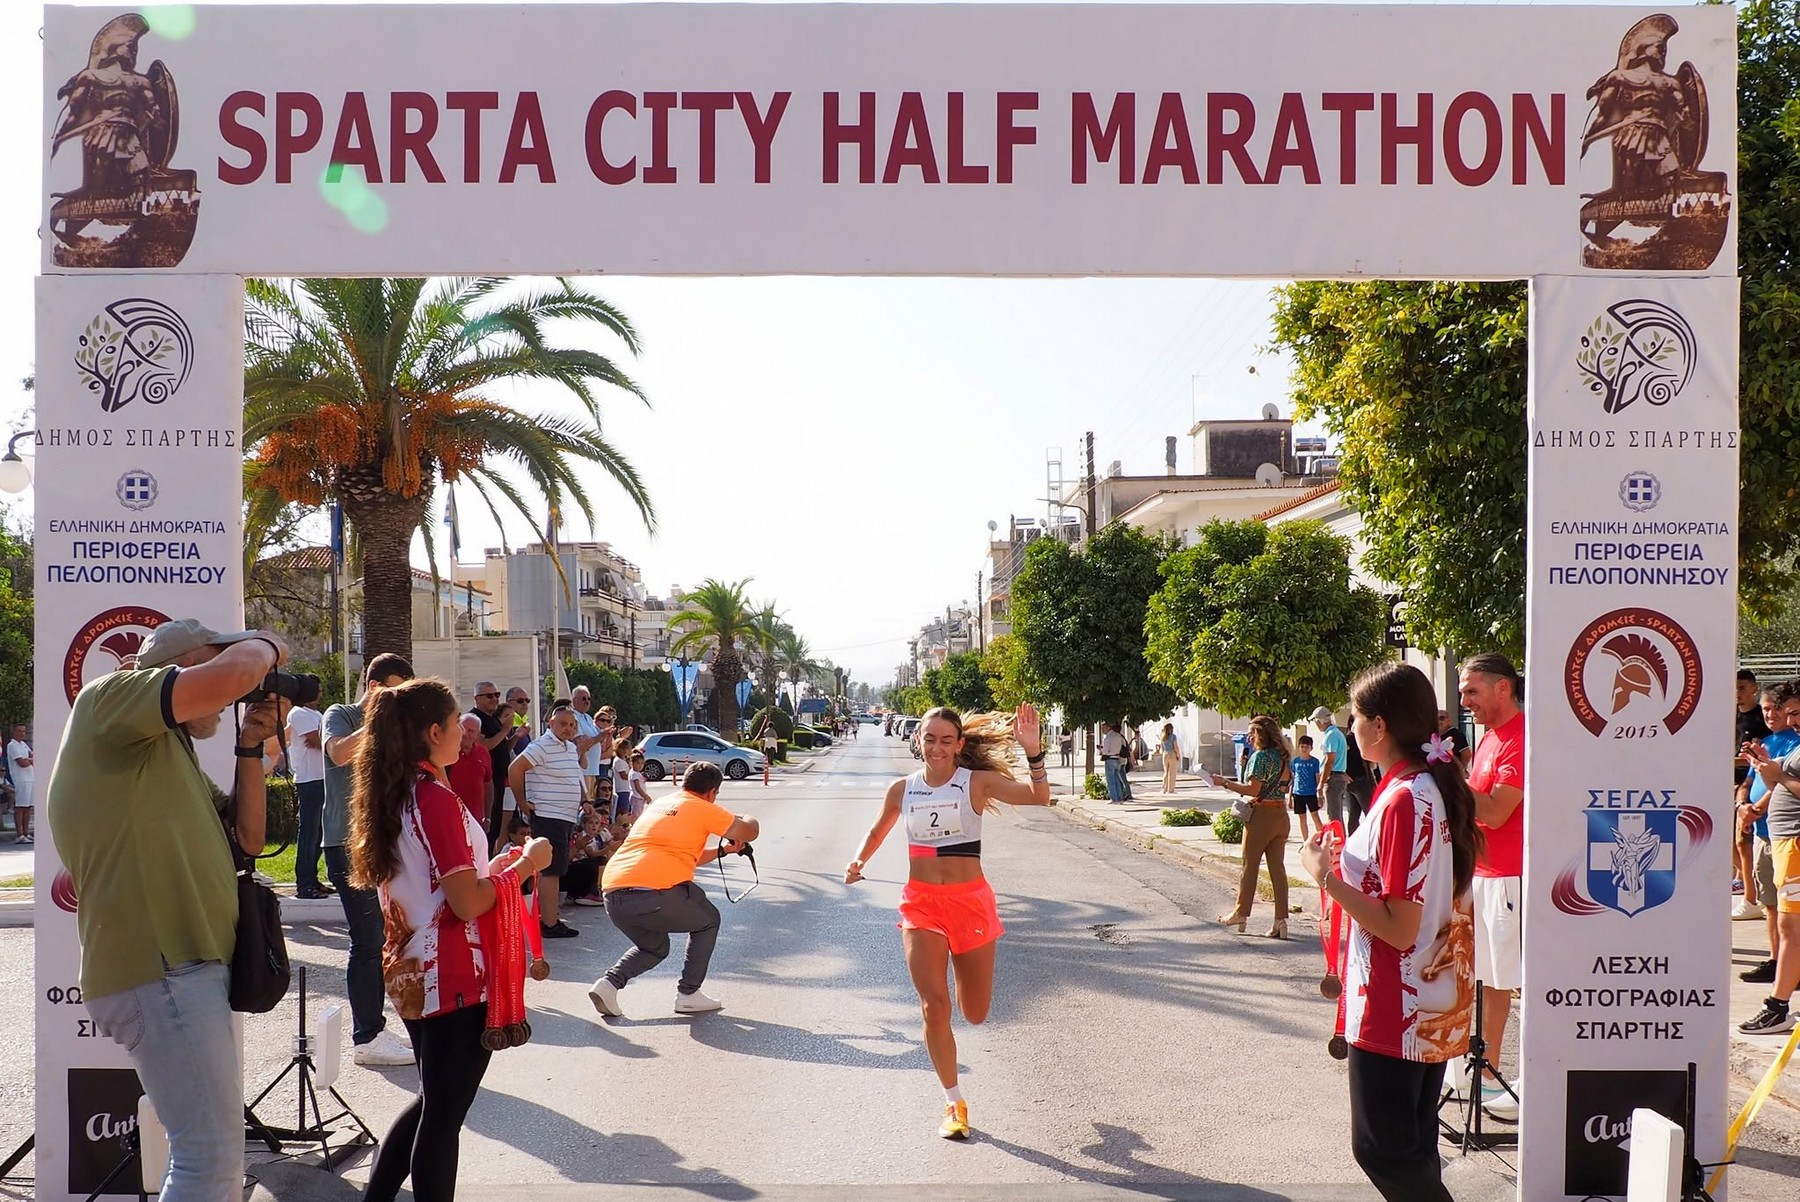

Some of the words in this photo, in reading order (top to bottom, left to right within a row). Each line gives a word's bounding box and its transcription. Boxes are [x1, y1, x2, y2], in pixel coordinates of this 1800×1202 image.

[218, 91, 556, 185] SPARTA
[585, 90, 792, 185] CITY
[823, 92, 1038, 183] HALF
[1072, 91, 1565, 186] MARATHON
[35, 429, 113, 447] ΔΗΜΟΣ
[127, 430, 234, 447] ΣΠΑΡΤΗΣ
[1535, 431, 1615, 447] ΔΗΜΟΣ
[1629, 431, 1736, 448] ΣΠΑΡΤΗΣ
[50, 520, 124, 533] ΕΛΛΗΝΙΚΗ
[130, 521, 225, 533] ΔΗΜΟΚΡΑΤΙΑ
[1552, 522, 1627, 534] ΕΛΛΗΝΙΚΗ
[1632, 522, 1728, 534] ΔΗΜΟΚΡΑΤΙΑ
[74, 542, 200, 559] ΠΕΡΙΦΕΡΕΙΑ
[1575, 543, 1703, 560] ΠΕΡΙΦΕΡΕΙΑ
[48, 566, 225, 583] ΠΕΛΟΠΟΝΝΗΣΟΥ
[1550, 568, 1728, 585] ΠΕΛΟΠΟΝΝΗΣΟΥ
[84, 613, 133, 644] ΔΡΟΜΕΙΣ
[1571, 649, 1595, 720] ΣΠΑΡΤΙΑΤΕΣ
[1586, 614, 1636, 646] ΔΡΟΜΕΙΣ
[1647, 617, 1691, 657] SPARTAN
[1678, 660, 1697, 716] RUNNERS
[1613, 724, 1658, 739] 2015
[1588, 790, 1676, 808] ΣΕΓΑΣ
[930, 812, 939, 827] 2
[1592, 957, 1668, 974] ΛΕΣΧΗ
[1546, 989, 1715, 1007] ΦΩΤΟΓΡΑΦΙΑΣ
[1576, 1022, 1683, 1039] ΣΠΑΡΤΗΣ
